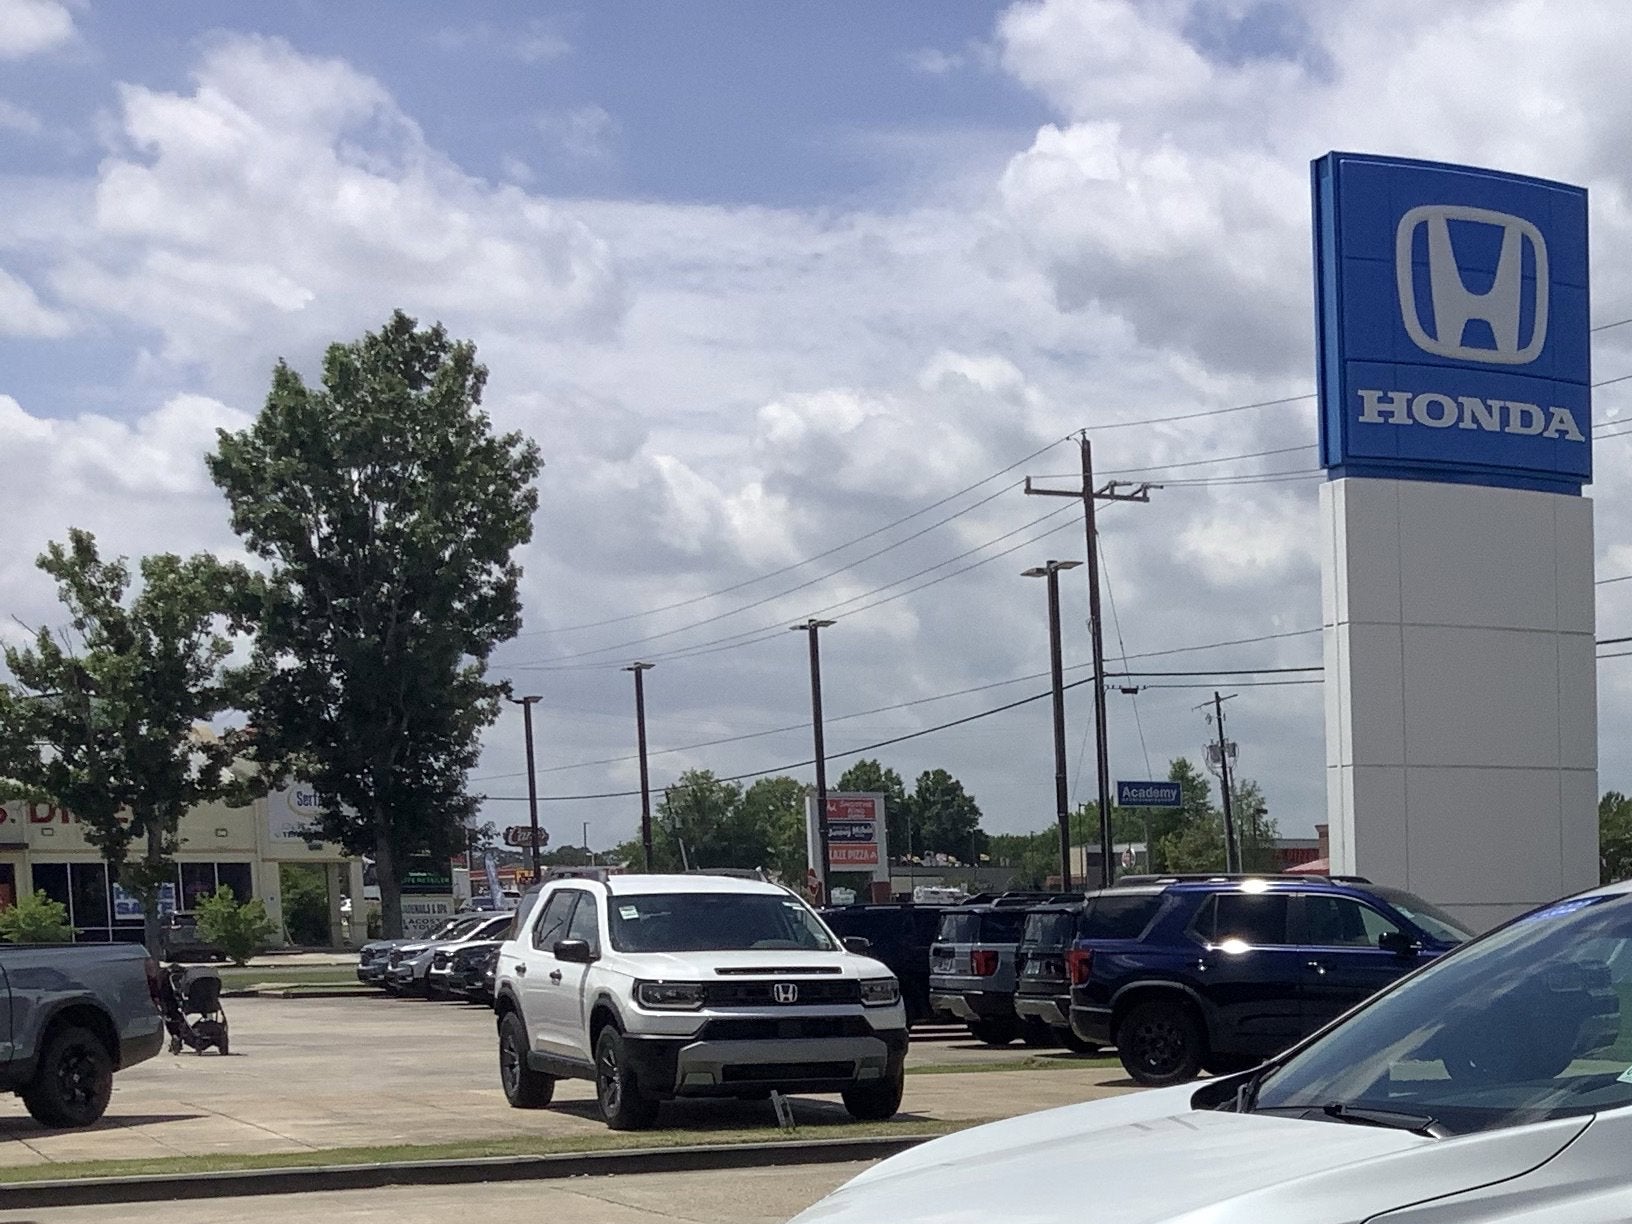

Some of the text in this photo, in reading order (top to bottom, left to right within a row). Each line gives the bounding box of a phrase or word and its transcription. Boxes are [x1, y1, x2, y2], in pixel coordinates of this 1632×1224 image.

[1357, 388, 1586, 442] HONDA
[1122, 785, 1178, 800] Academy
[847, 849, 869, 860] PIZZA
